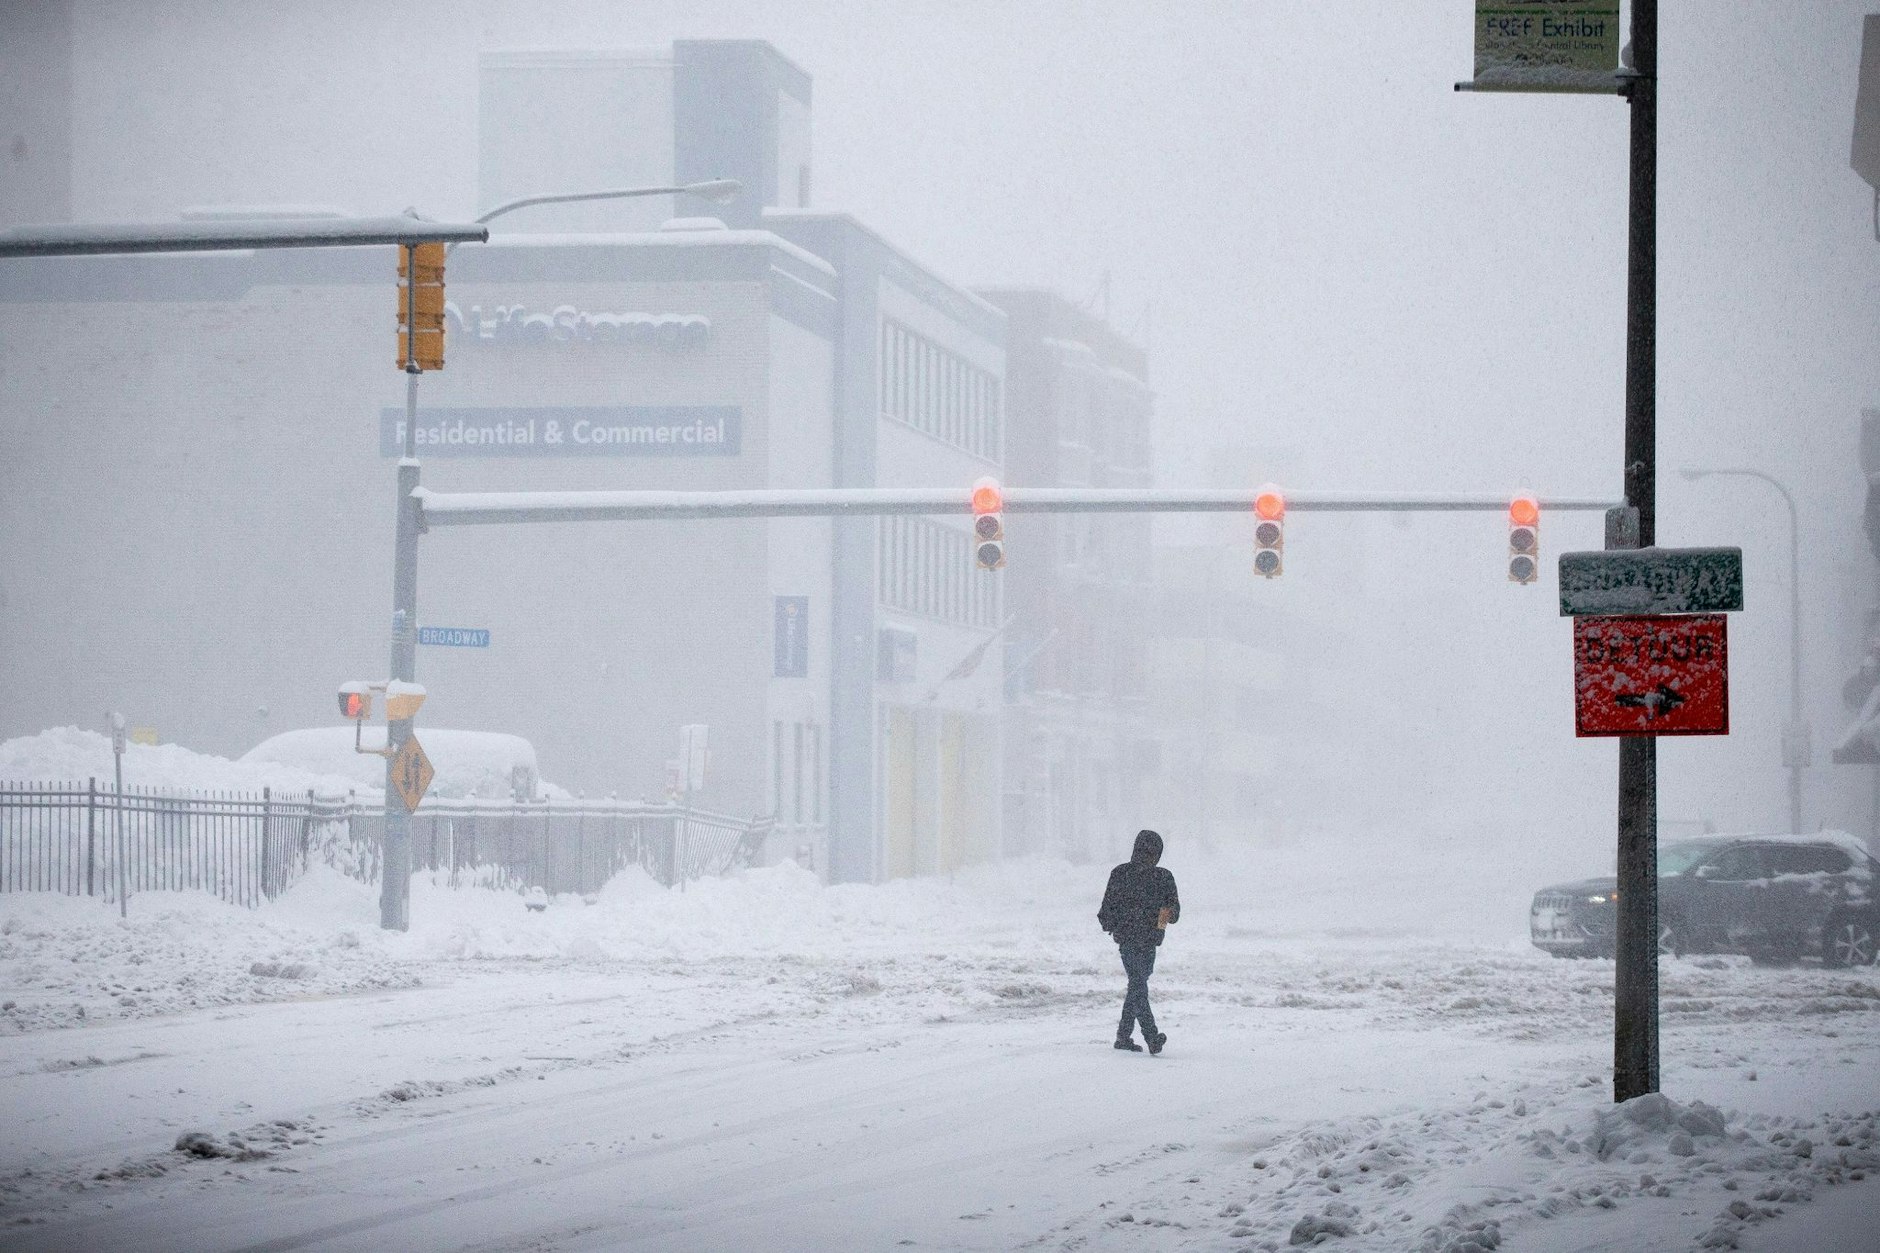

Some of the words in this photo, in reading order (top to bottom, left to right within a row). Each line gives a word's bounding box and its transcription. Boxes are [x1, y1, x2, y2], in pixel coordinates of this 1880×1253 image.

[1542, 17, 1605, 38] Exhibit
[396, 419, 535, 445] Residential
[543, 420, 564, 445] &
[572, 418, 725, 444] Commercial
[422, 629, 487, 645] BROADWAY
[1586, 635, 1714, 664] DETOUR
